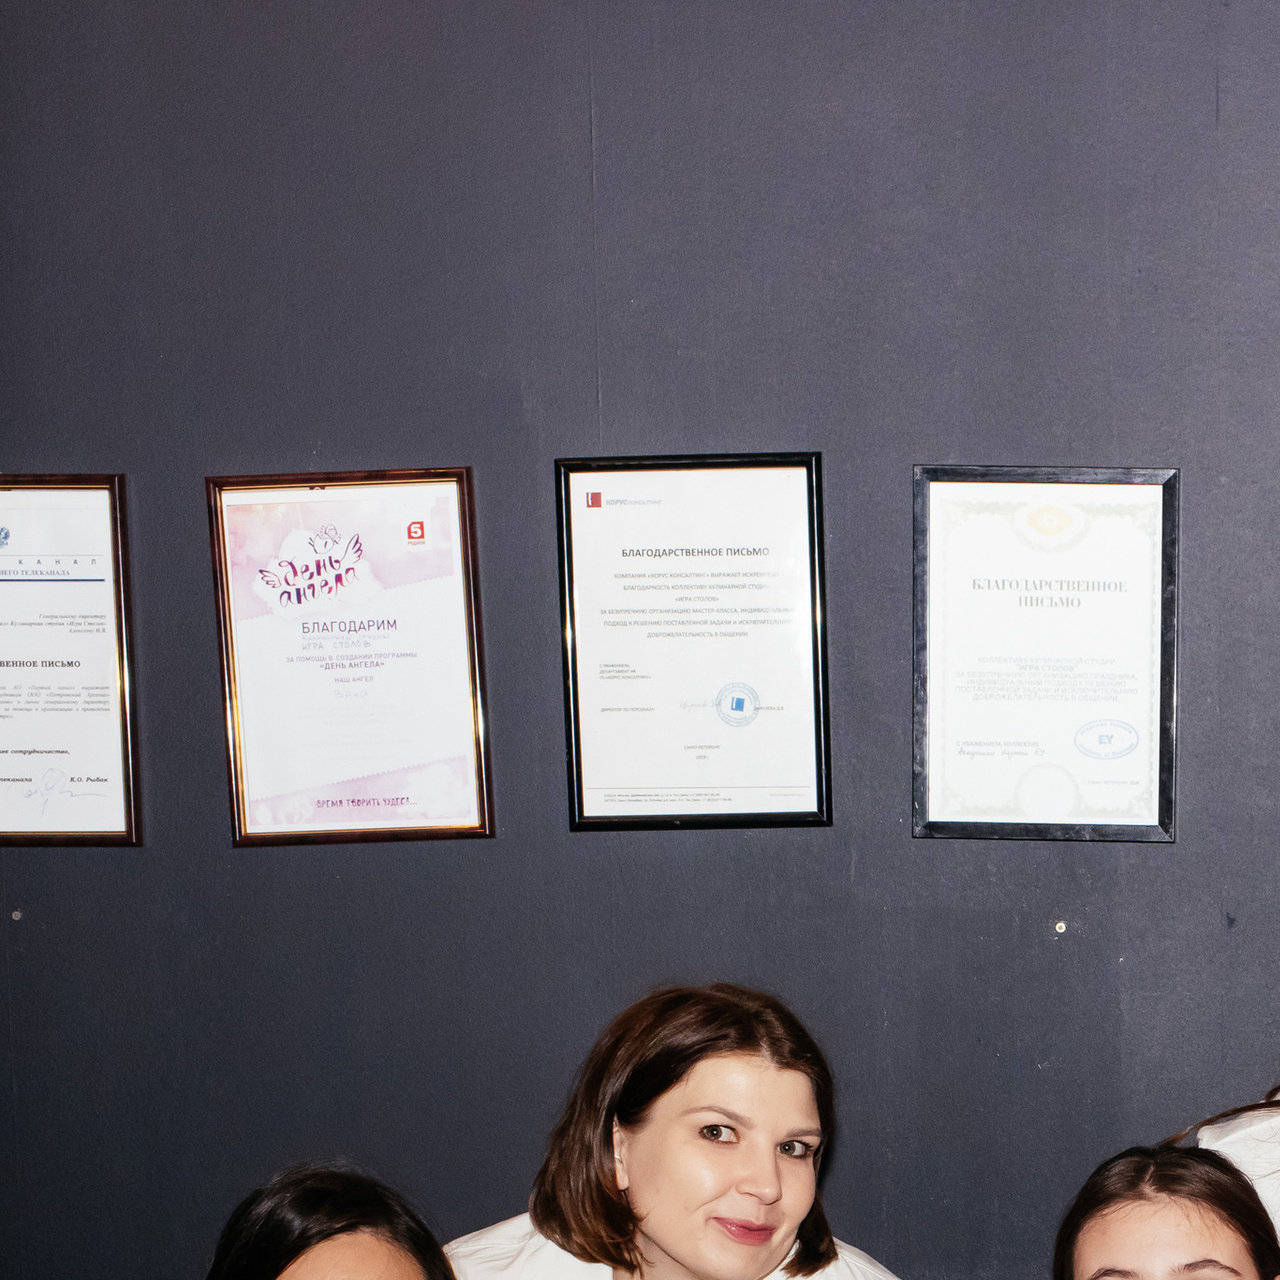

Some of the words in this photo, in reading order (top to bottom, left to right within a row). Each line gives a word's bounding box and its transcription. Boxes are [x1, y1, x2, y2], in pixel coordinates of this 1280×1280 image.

[622, 548, 723, 559] БЛАГОДАРСТВЕННОЕ
[726, 547, 770, 557] ПИСЬМО
[972, 578, 1128, 592] БЛАГОДАРСТВЕННОЕ
[1018, 596, 1081, 608] ПИСЬМО
[302, 619, 397, 634] БЛАГОДАРИМ
[41, 660, 81, 668] ПИСЬМО
[320, 662, 346, 670] «ДЕНЬ
[1061, 687, 1138, 695] ИСКЛЮЧИТЕЛЬНУЮ
[1098, 734, 1114, 745] EY
[316, 800, 344, 808] ВРЕМЯ
[346, 798, 380, 807] ТВОРИТЬ
